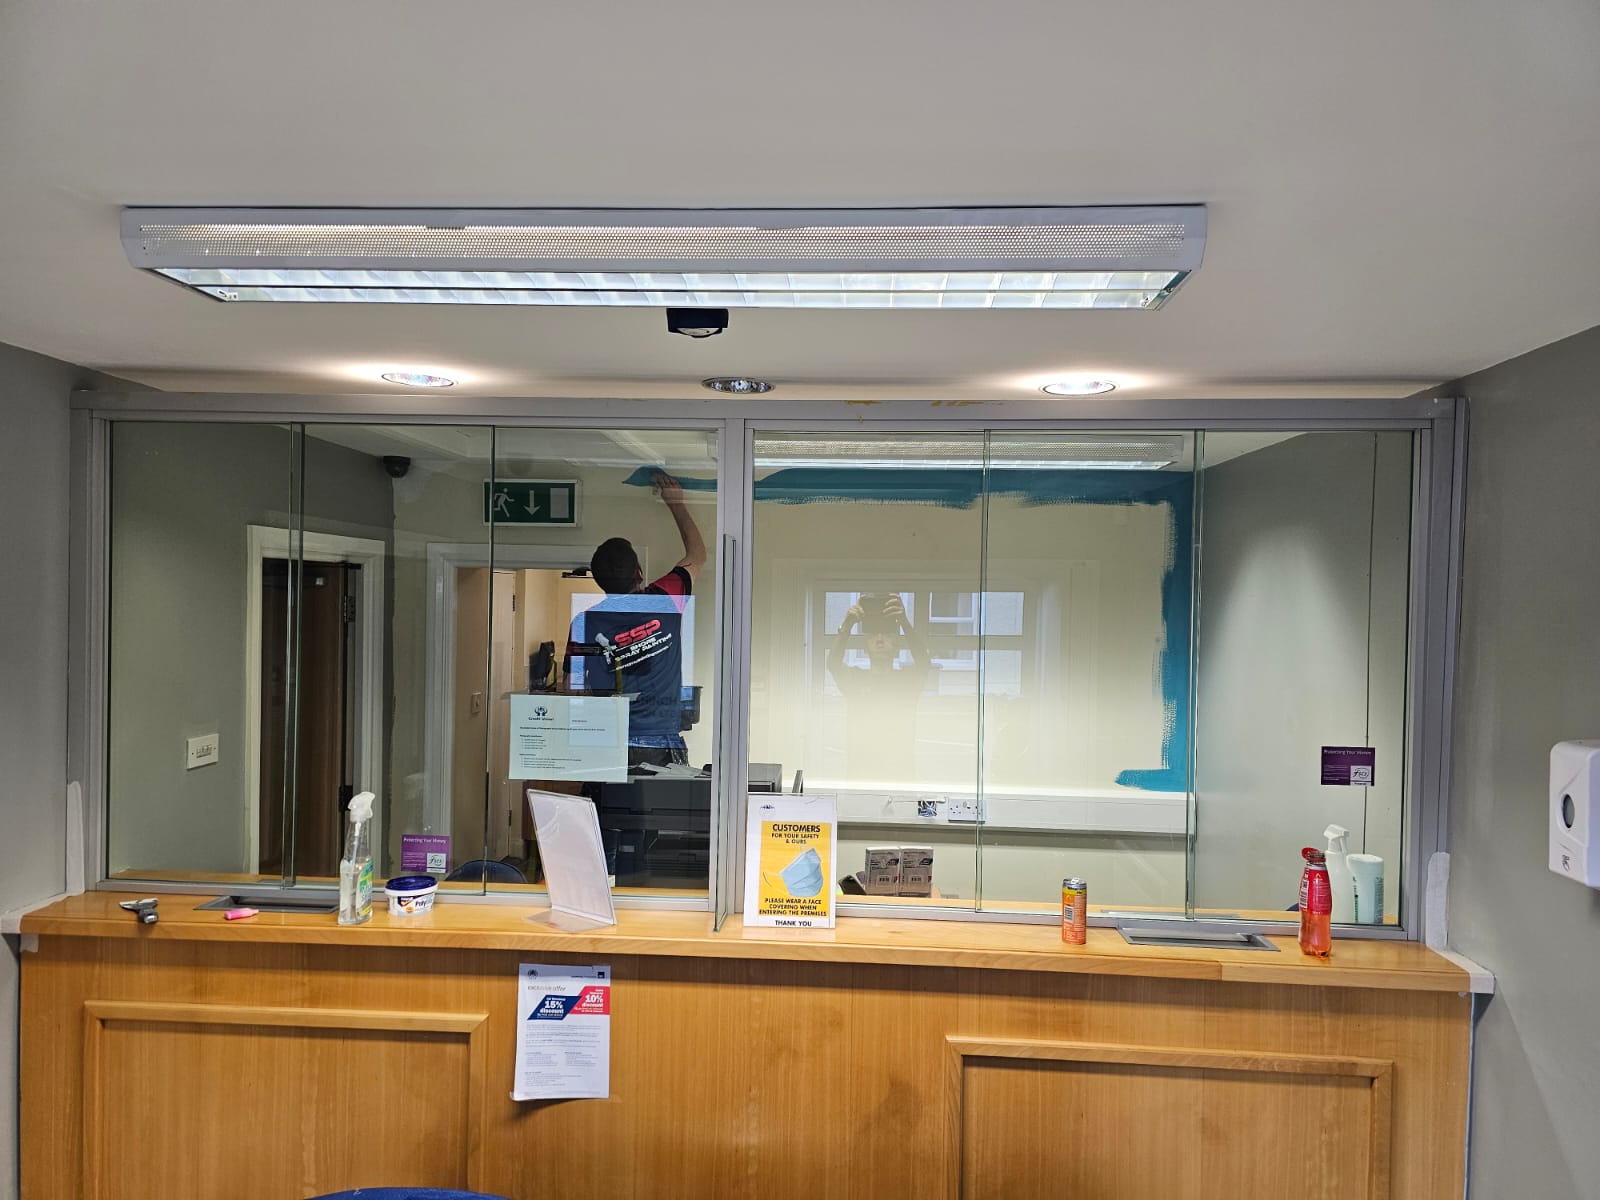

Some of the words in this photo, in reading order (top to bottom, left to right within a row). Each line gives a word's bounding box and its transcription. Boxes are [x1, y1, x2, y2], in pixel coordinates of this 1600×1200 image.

[614, 619, 660, 647] SSP
[772, 823, 821, 832] CUSTOMERS
[585, 995, 603, 1003] 10%
[544, 1001, 563, 1009] 15%
